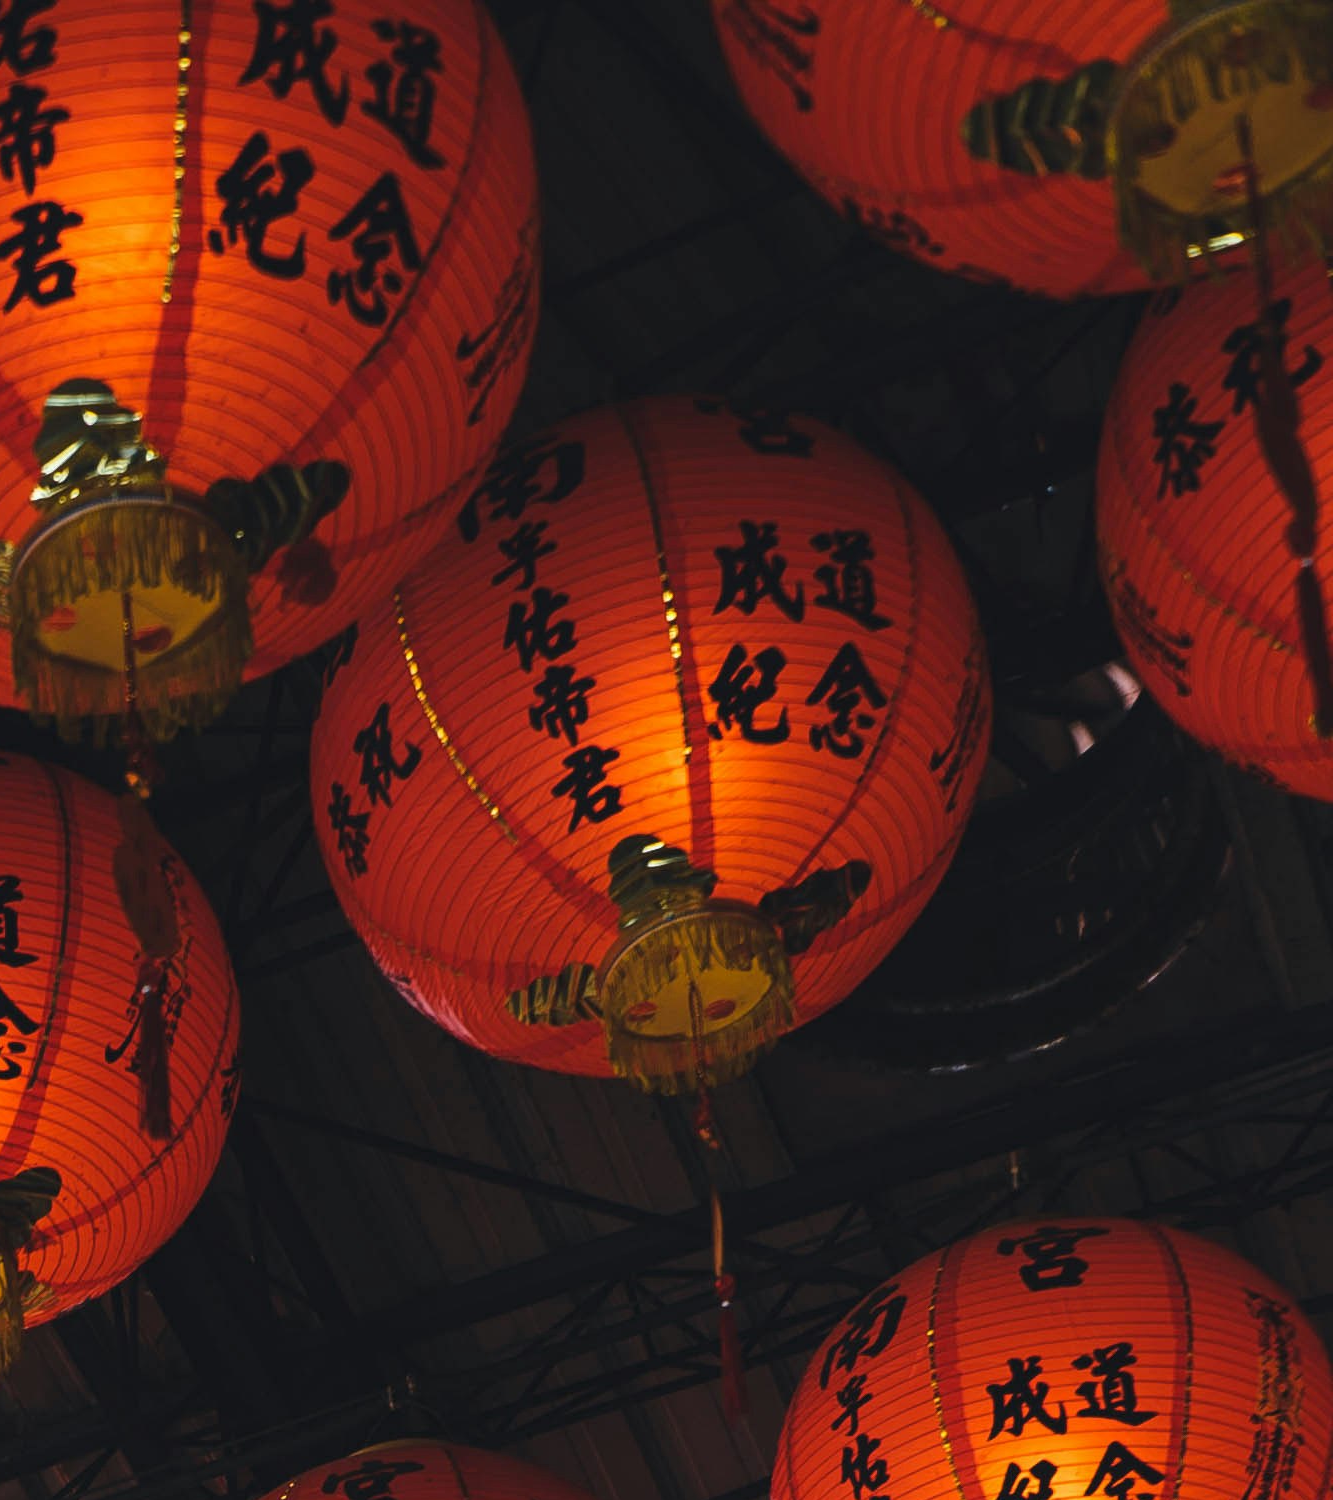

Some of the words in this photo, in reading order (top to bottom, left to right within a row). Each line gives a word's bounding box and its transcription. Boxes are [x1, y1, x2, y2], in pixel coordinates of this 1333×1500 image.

[207, 132, 427, 327] 紀念
[493, 519, 621, 832] 孚佑帝君
[986, 1342, 1158, 1441] 成道
